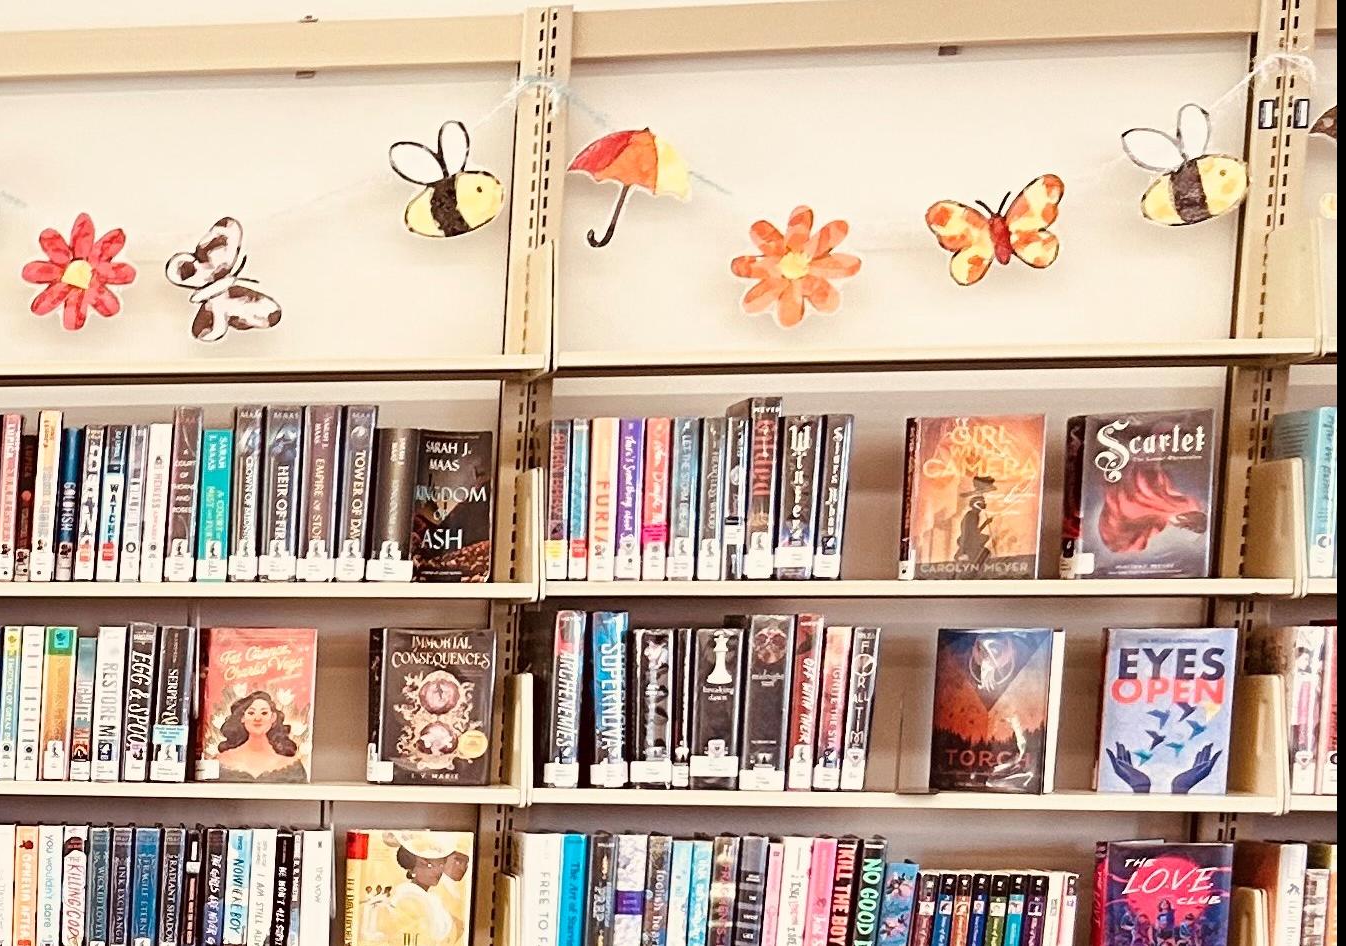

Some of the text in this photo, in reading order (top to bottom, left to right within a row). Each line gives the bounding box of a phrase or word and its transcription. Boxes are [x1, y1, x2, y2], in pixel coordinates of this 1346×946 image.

[218, 436, 226, 469] SARAH
[426, 441, 472, 456] SARAH J.
[951, 426, 1013, 445] GIRL
[1094, 420, 1206, 484] Scarlet
[244, 455, 255, 493] CROWN
[313, 458, 325, 497] EMPIRE
[350, 450, 367, 517] TOWER OF
[430, 459, 460, 472] MAAS
[680, 433, 692, 502] LET THE STORM
[923, 459, 1037, 480] CAMERA
[61, 482, 77, 532] GOLDFISH
[275, 465, 289, 518] HEIR OF
[422, 529, 463, 551] ASH
[920, 561, 1029, 574] CAROLYN MEYER
[391, 652, 491, 668] CONSEQUENCES
[411, 636, 473, 650] IMMORTAL
[131, 650, 153, 687] EGG
[800, 657, 815, 681] OFF
[1118, 648, 1227, 681] EYES
[100, 662, 118, 721] RESTORE
[555, 651, 578, 748] ARCHENEMIES
[600, 642, 625, 750] SUPERNOVA
[1110, 676, 1226, 705] OPEN
[167, 859, 178, 903] RADIANT
[1124, 857, 1155, 868] THE
[115, 866, 126, 942] INK EXCHANGE
[229, 858, 245, 934] NOWHERE BOY
[255, 882, 264, 924] AM STILL
[538, 872, 550, 931] FREE TO
[654, 869, 667, 911] foolish
[829, 850, 854, 945] KILL THE BOY
[857, 858, 883, 935] NO GOOD
[1176, 896, 1221, 905] CLUB
[44, 903, 53, 928] dare
[276, 908, 285, 922] ALL
